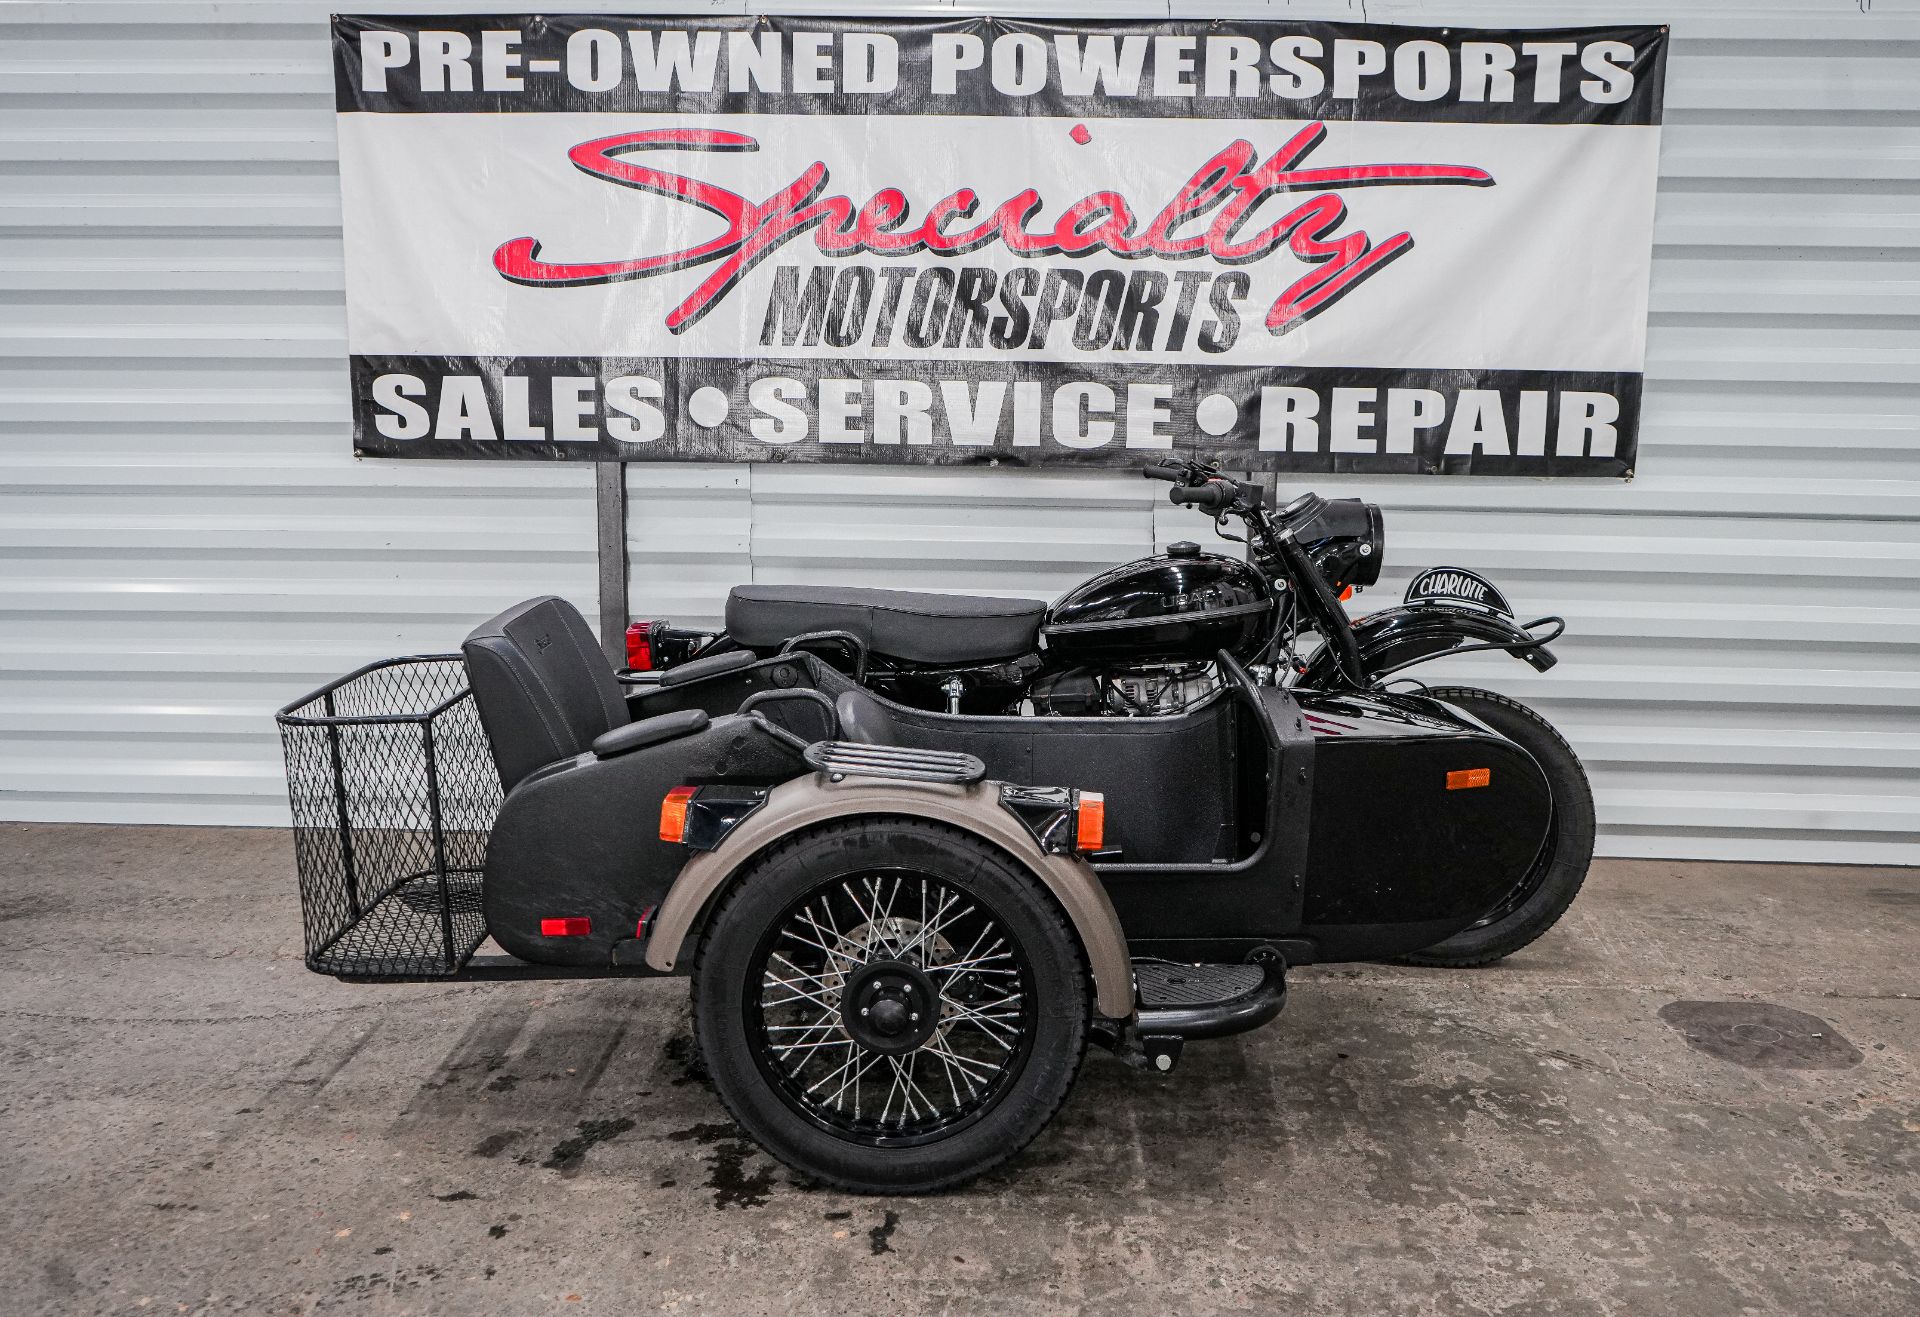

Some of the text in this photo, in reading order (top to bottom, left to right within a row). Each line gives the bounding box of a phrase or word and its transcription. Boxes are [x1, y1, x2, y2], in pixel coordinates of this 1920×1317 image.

[360, 29, 1635, 103] PRE-OWNED POWERSPORTS
[492, 120, 1497, 335] Specialty
[759, 266, 1250, 354] MOTORSPORTS
[372, 374, 1620, 458] SALES SERVICE REPAIR
[1420, 574, 1489, 601] CHARLOTTE
